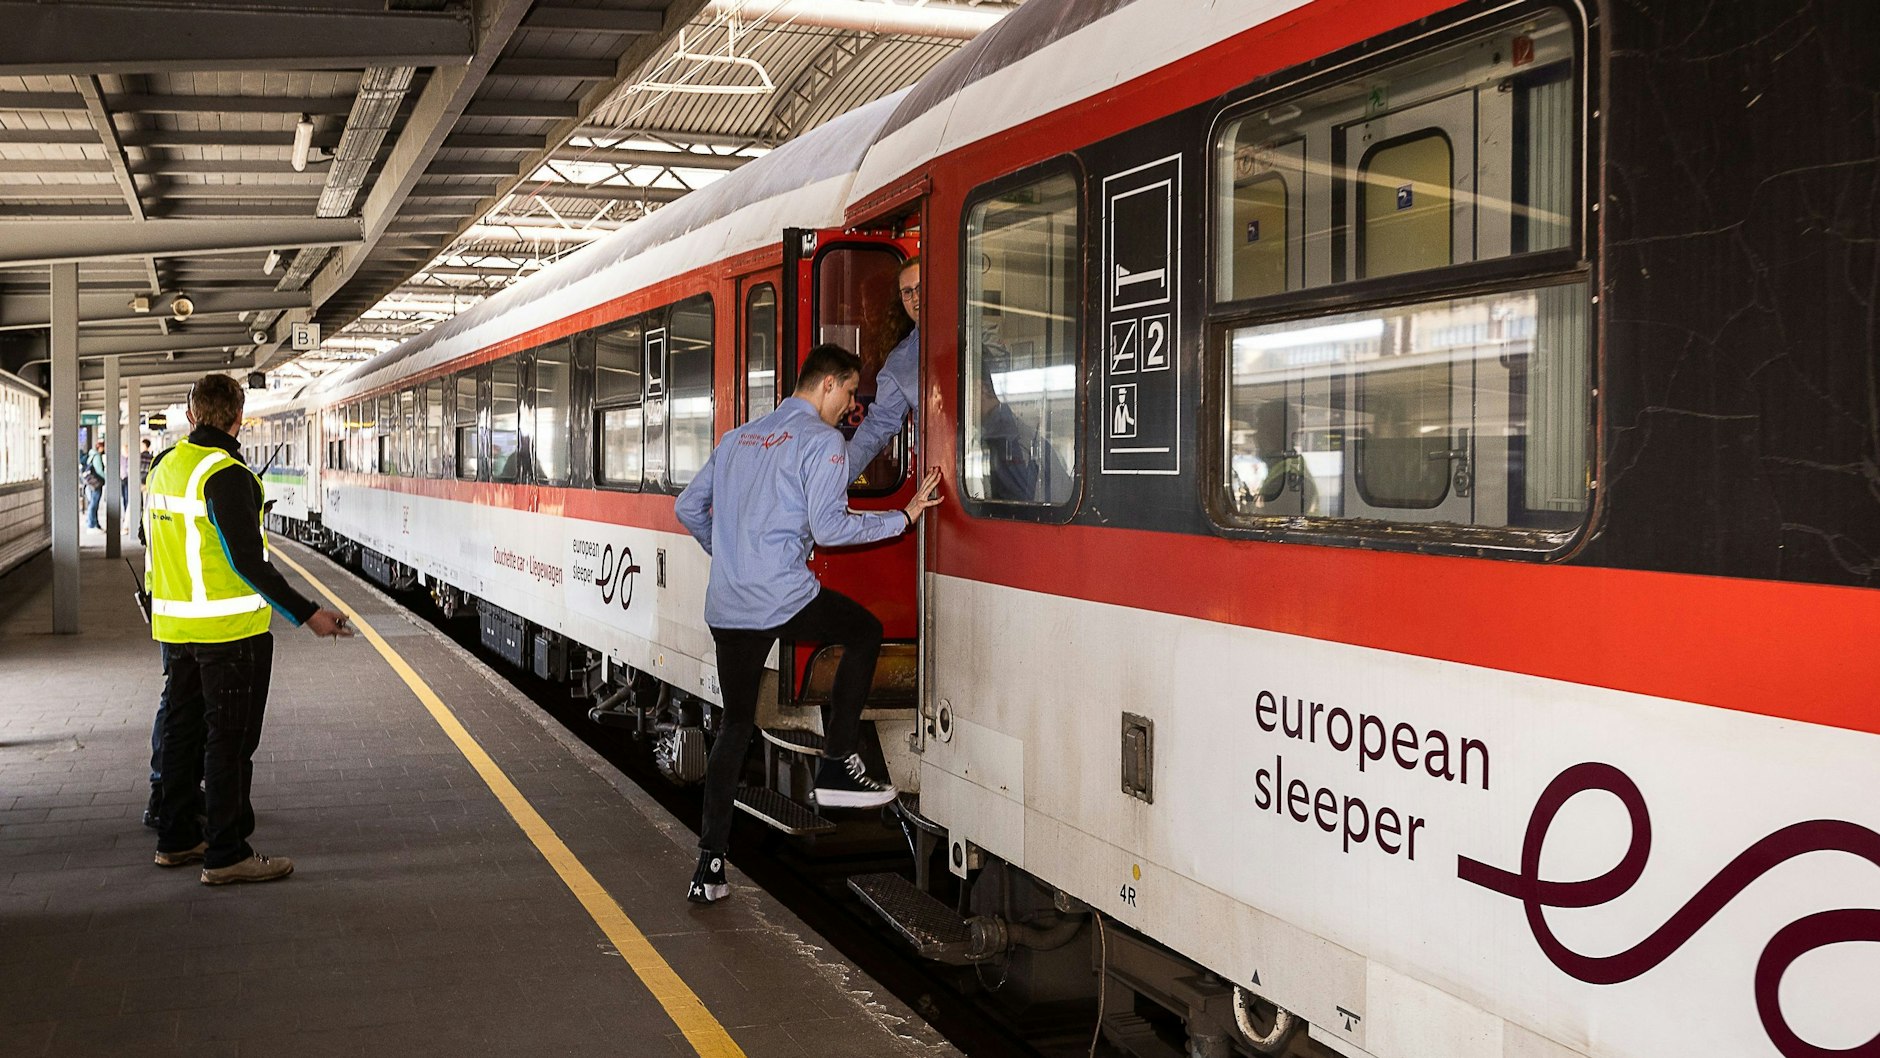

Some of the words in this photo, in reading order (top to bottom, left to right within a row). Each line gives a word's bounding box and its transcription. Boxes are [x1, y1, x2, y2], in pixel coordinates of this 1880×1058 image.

[298, 331, 309, 345] B
[1147, 321, 1164, 366] 2
[573, 539, 600, 559] european
[493, 546, 516, 570] Couchette
[516, 556, 525, 572] car
[530, 555, 563, 587] Liegewagen
[573, 560, 593, 587] sleeper
[1255, 690, 1490, 791] european
[1254, 754, 1426, 861] sleeper
[1119, 883, 1137, 908] 4R
